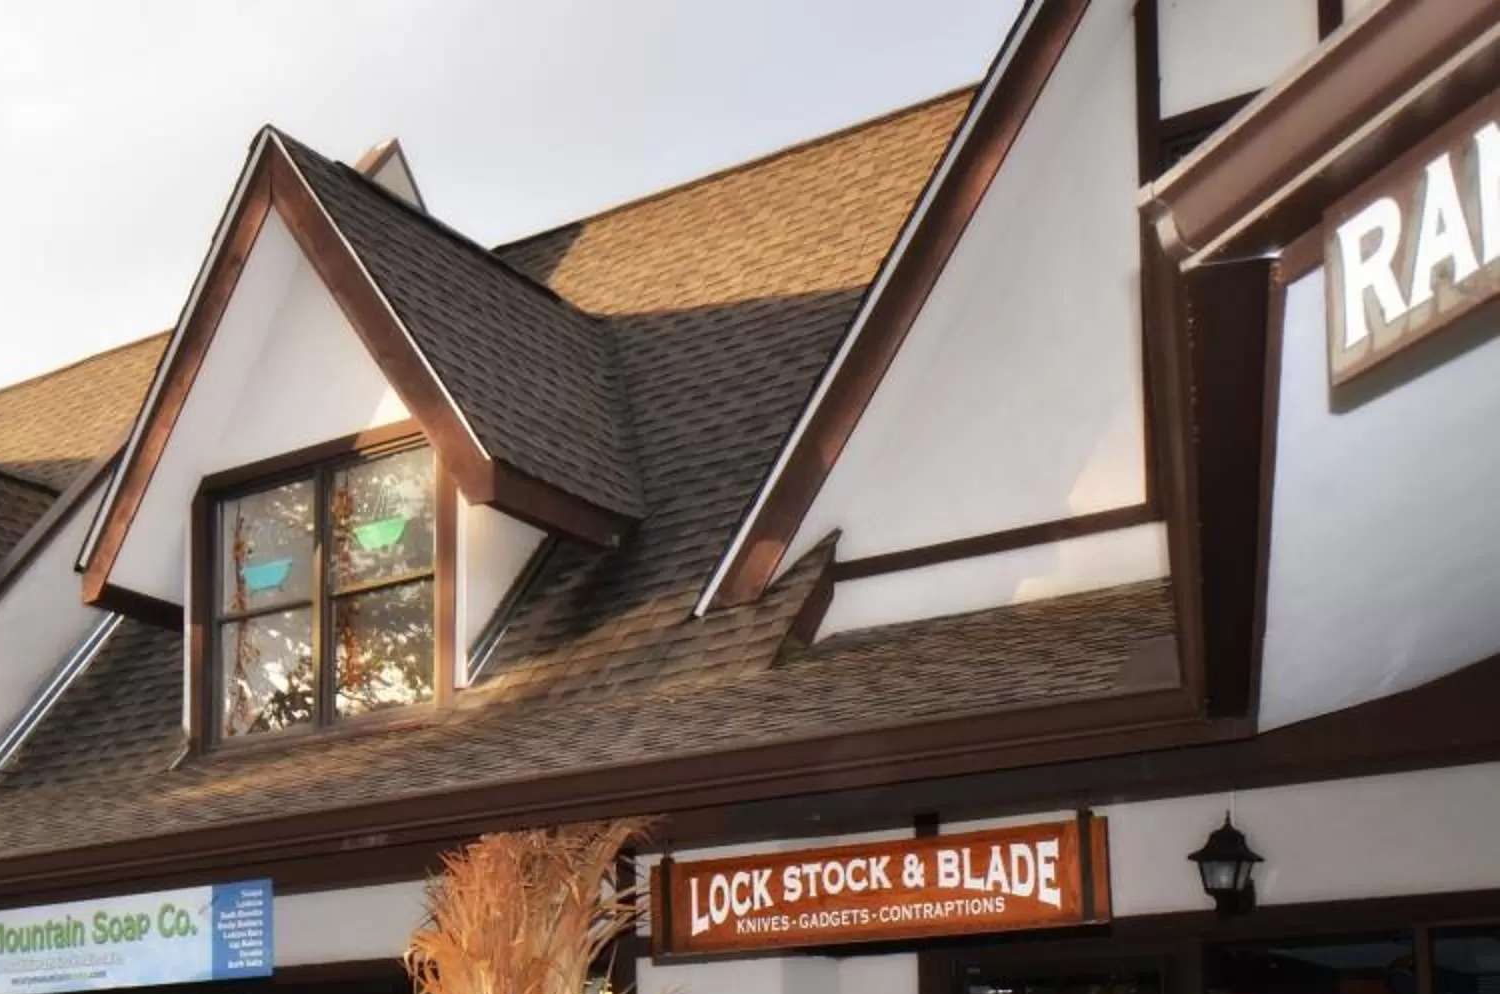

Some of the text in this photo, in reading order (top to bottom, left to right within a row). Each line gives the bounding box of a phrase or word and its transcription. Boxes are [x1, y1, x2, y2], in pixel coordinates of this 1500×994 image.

[690, 837, 1061, 936] LOCK STOCK & BLADE
[92, 910, 150, 944] Soap
[158, 903, 198, 938] Co.
[737, 896, 1005, 934] KNIVES GADGETS CONTRAPTIONS
